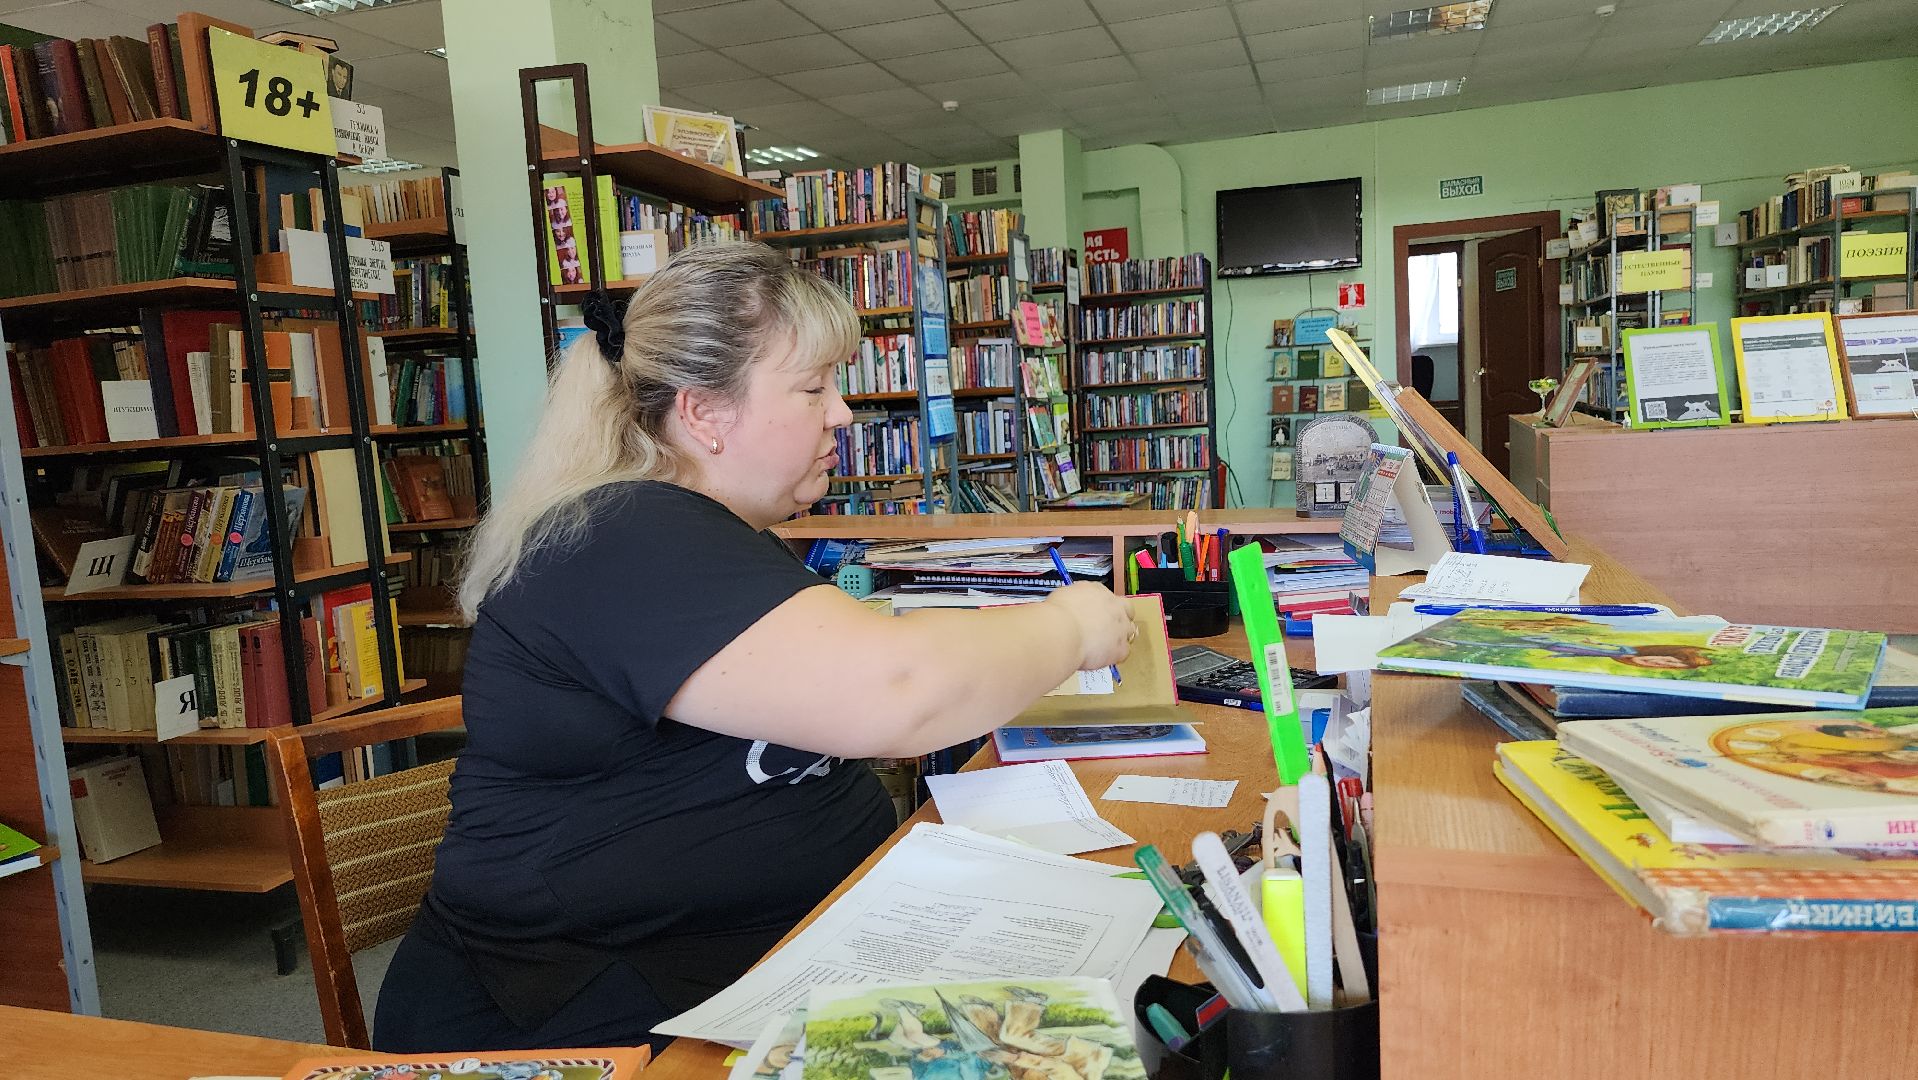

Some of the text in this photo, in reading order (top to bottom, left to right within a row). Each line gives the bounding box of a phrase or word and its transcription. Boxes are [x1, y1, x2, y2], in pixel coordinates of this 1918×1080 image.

[239, 69, 320, 118] 18+
[1442, 184, 1480, 198] ВЫХОД
[1086, 235, 1103, 248] АЯ
[1846, 246, 1904, 258] ПОЭЗИЯ
[88, 554, 117, 578] Щ
[179, 689, 199, 715] Я
[1789, 903, 1918, 928] ЕЙНИКИ
